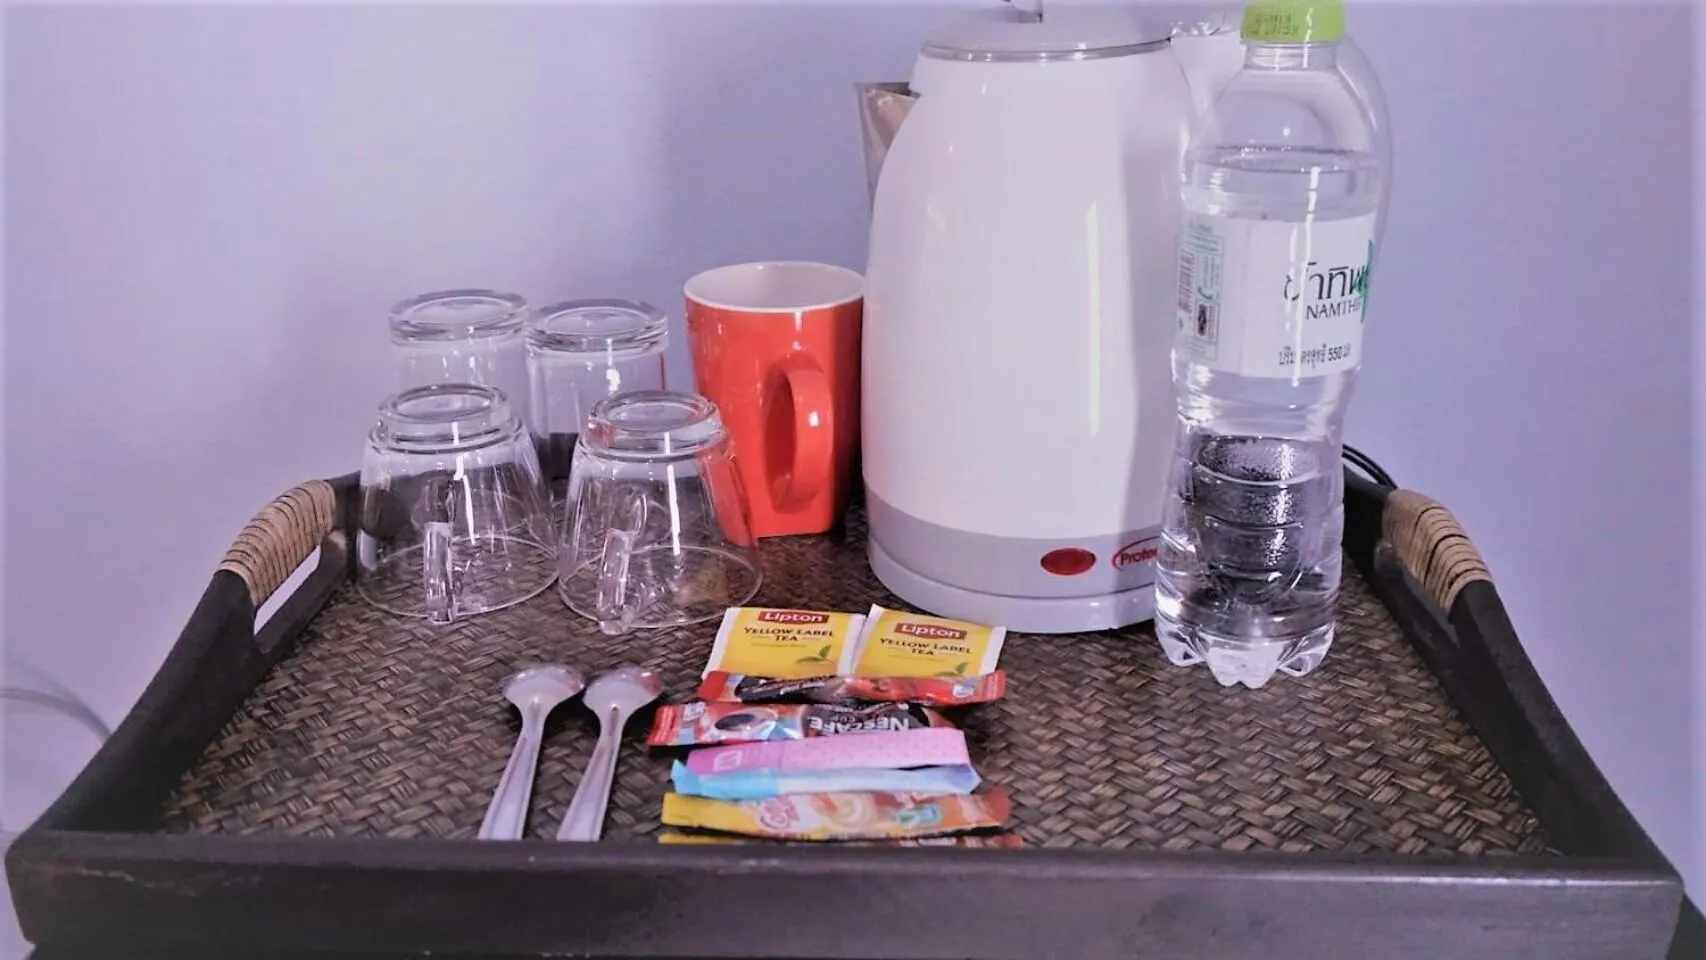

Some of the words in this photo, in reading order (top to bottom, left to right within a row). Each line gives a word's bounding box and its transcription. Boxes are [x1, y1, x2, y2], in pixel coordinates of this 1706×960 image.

[1120, 548, 1158, 565] Prote
[763, 610, 823, 623] Lipton
[796, 628, 834, 637] LABEL
[900, 624, 961, 638] Lipton
[880, 638, 930, 649] YELLOW
[932, 643, 972, 654] LABEL
[911, 648, 935, 656] TEA
